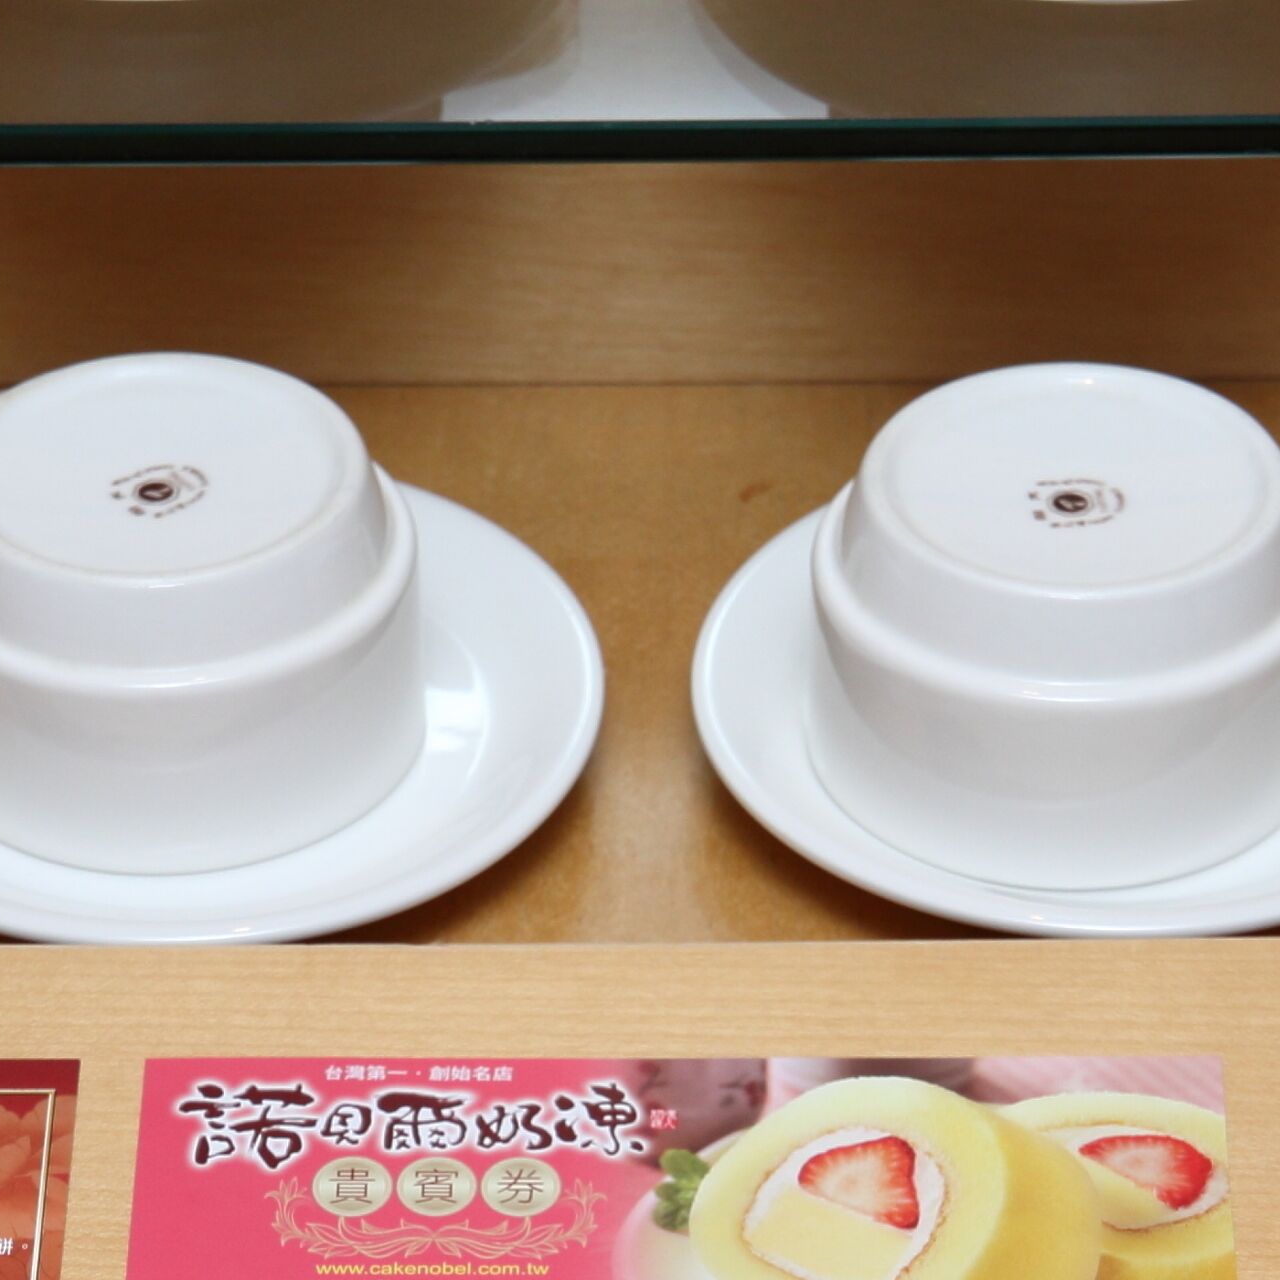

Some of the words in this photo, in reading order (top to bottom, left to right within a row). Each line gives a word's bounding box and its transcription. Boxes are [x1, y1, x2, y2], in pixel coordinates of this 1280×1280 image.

[178, 1083, 645, 1169] 諾貝爾奶凍
[328, 1167, 547, 1205] 貴賓券
[315, 1262, 550, 1276] www.cakenobel.com.tw
